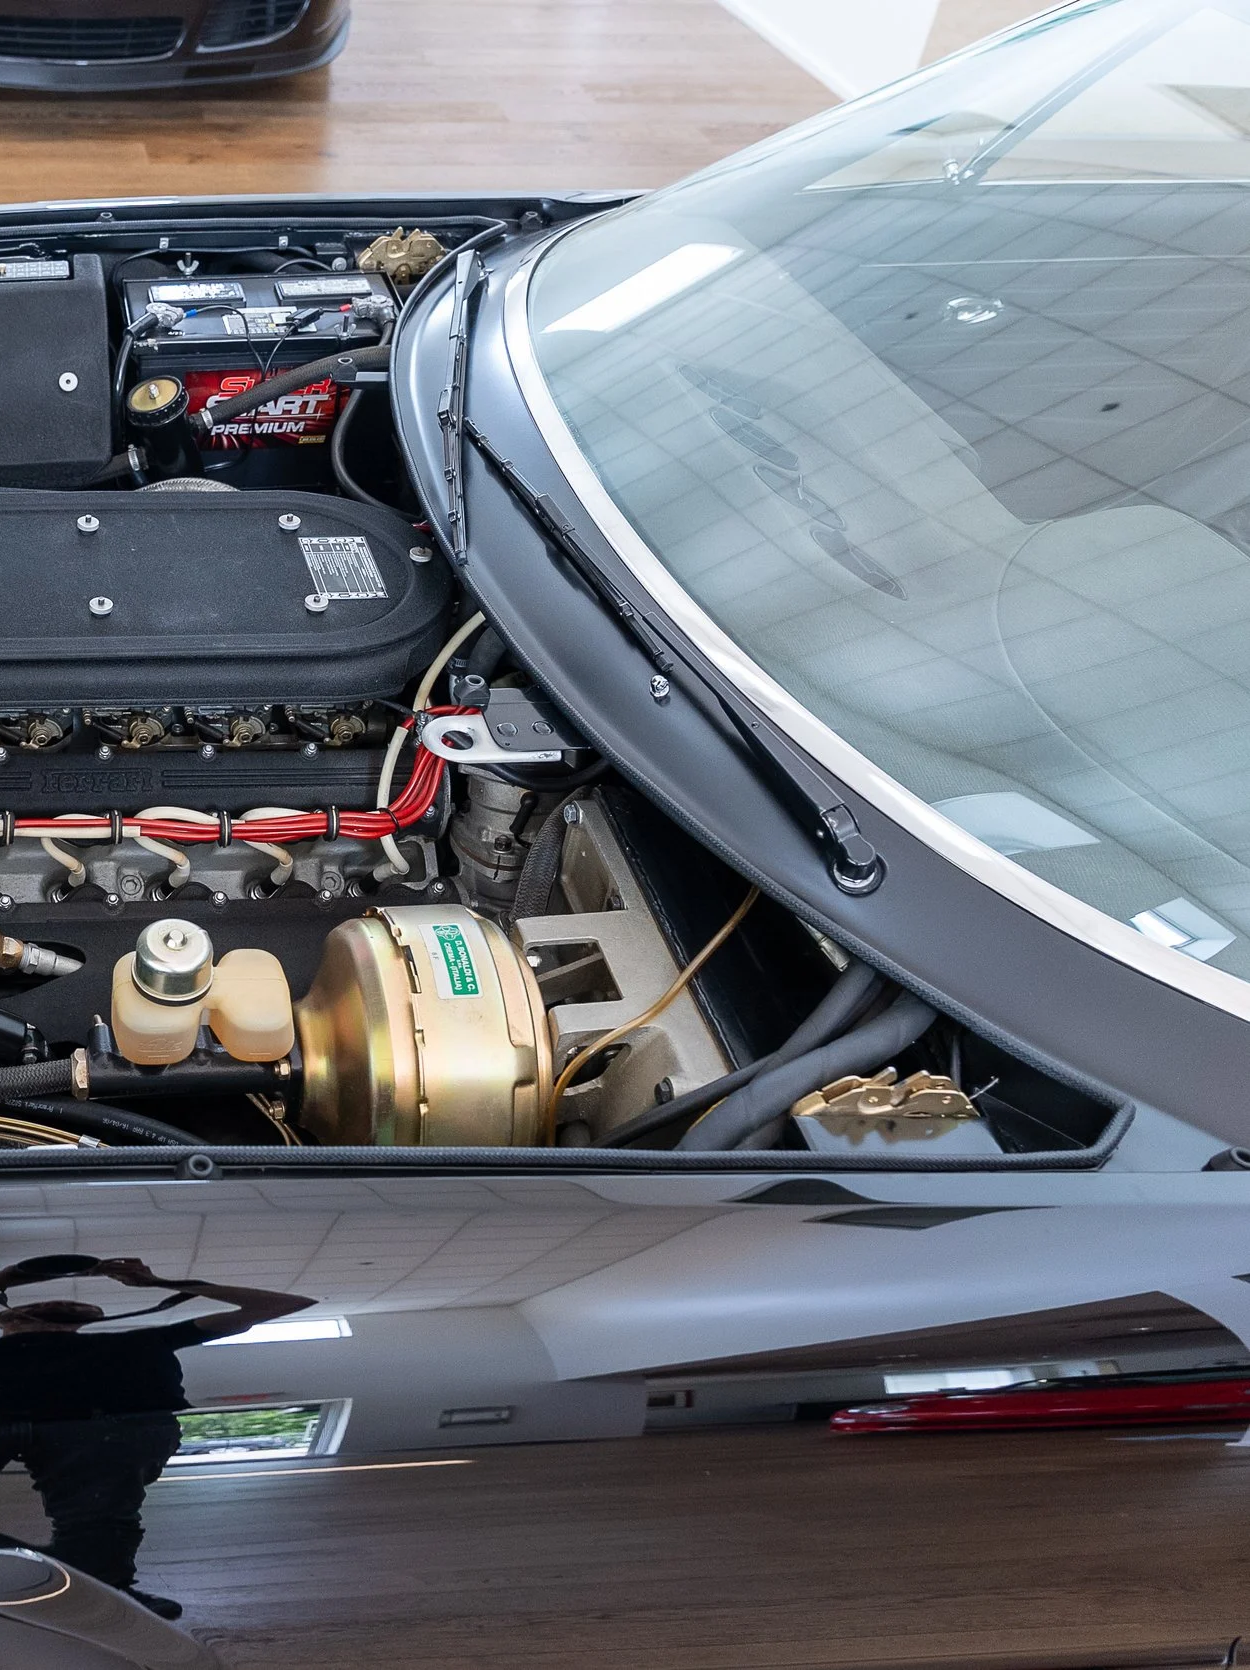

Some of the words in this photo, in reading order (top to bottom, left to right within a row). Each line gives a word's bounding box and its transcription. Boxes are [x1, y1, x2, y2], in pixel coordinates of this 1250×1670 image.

[210, 421, 306, 436] PREMIUM
[41, 768, 153, 793] Ferrari
[444, 942, 455, 962] CREMA
[450, 965, 463, 990] (ITALIA)
[456, 946, 472, 976] BONALDI
